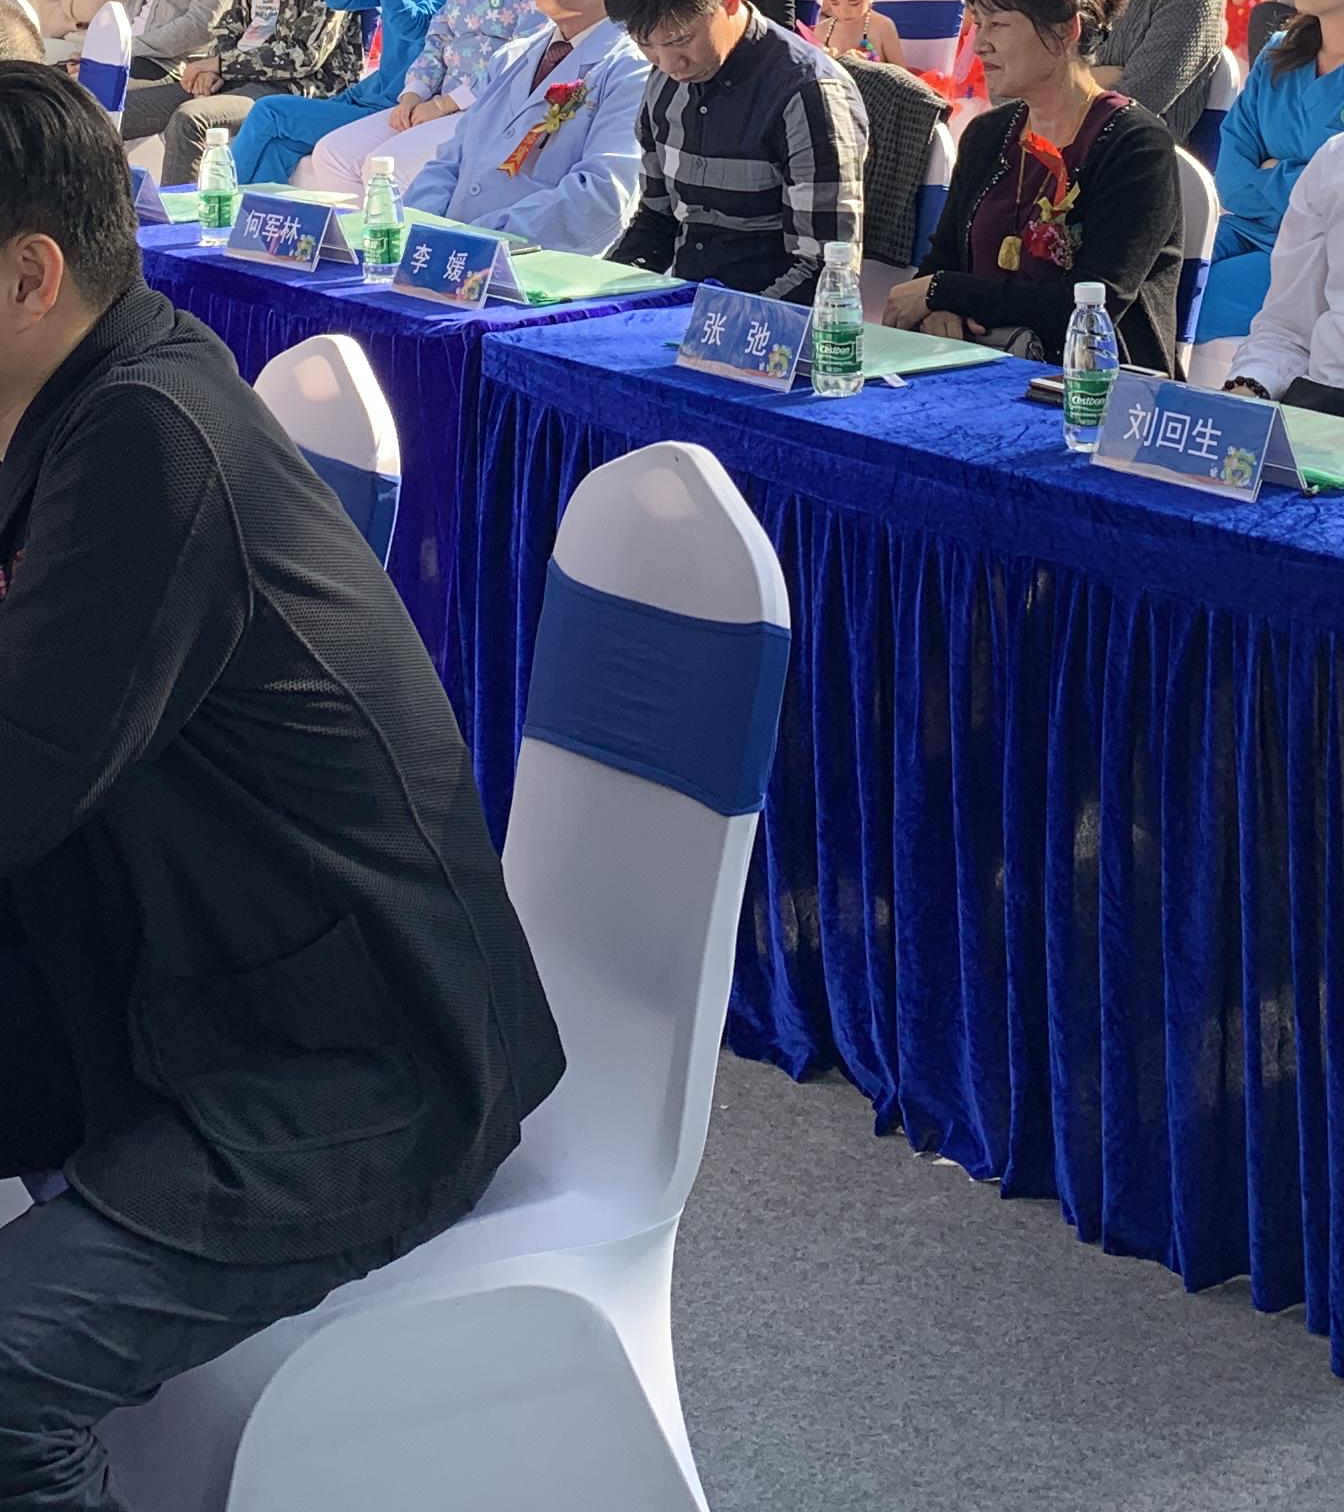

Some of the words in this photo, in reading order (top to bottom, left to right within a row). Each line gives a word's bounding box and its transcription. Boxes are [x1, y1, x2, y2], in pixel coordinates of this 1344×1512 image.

[243, 208, 302, 245] 何军林
[700, 311, 772, 357] 张弛
[1122, 402, 1222, 461] 刘回生
